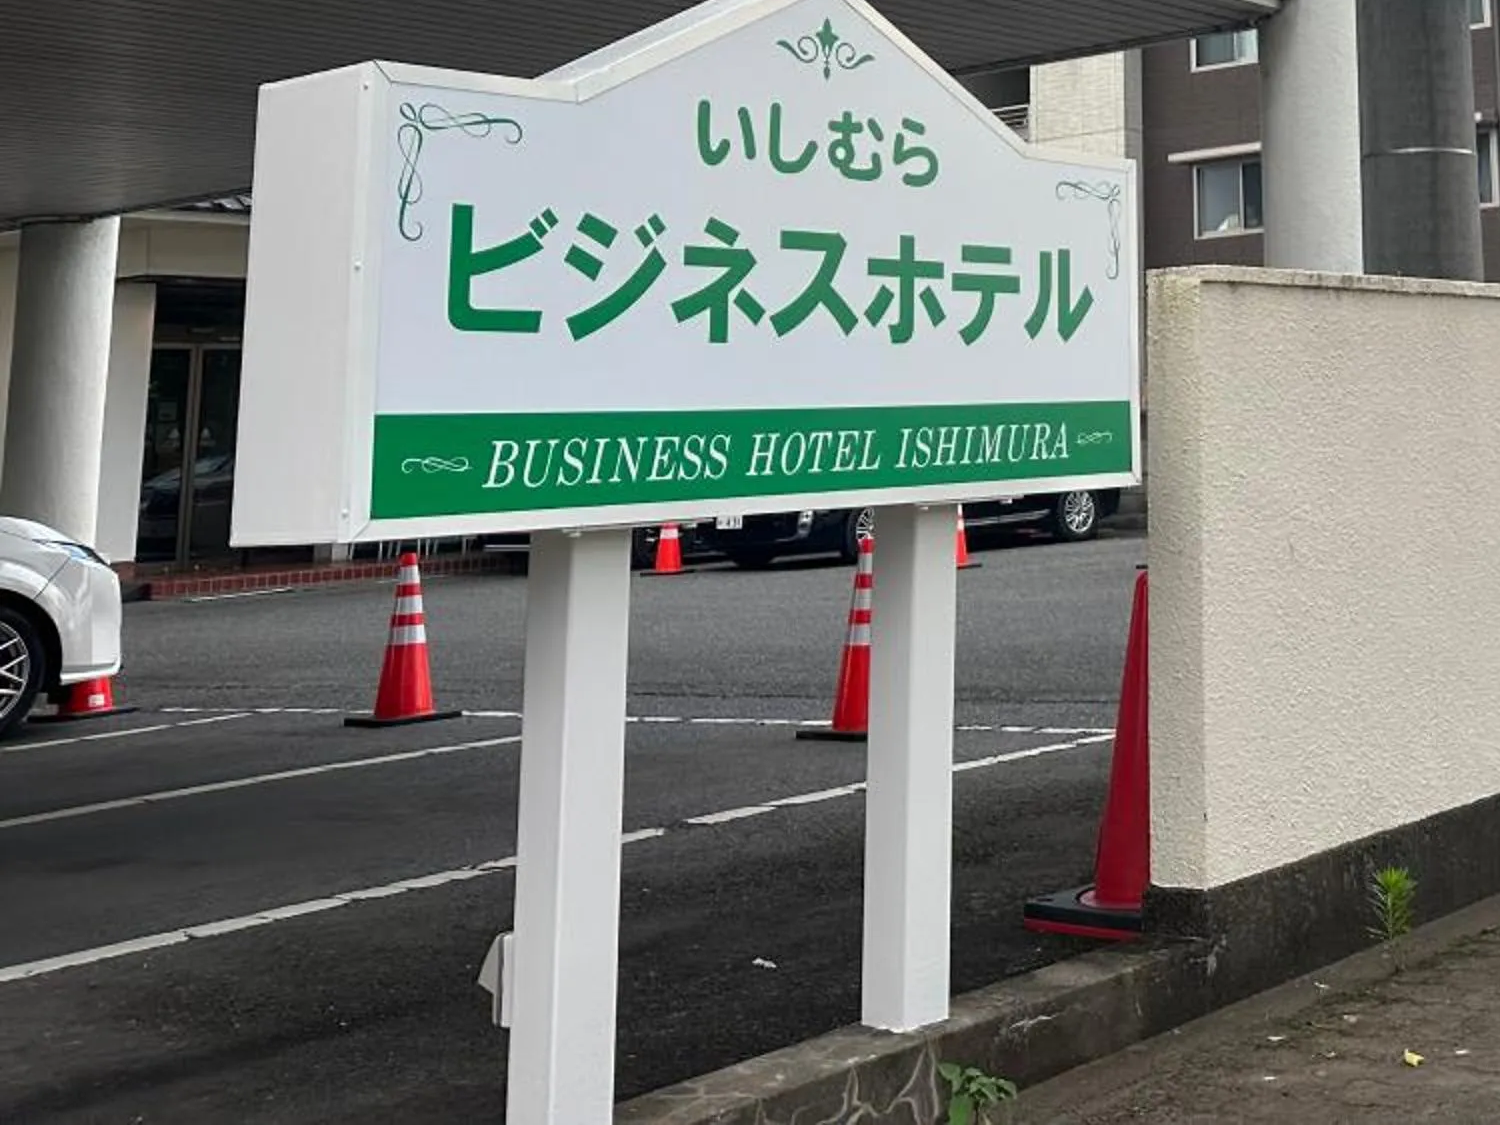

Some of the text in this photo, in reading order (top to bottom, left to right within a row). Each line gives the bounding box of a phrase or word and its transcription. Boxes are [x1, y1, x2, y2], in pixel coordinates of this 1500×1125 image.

[697, 100, 940, 187] いしむら
[447, 202, 1094, 346] ビジネスホテル
[482, 422, 1070, 489] BUSINESS HOTEL ISHIMURA
